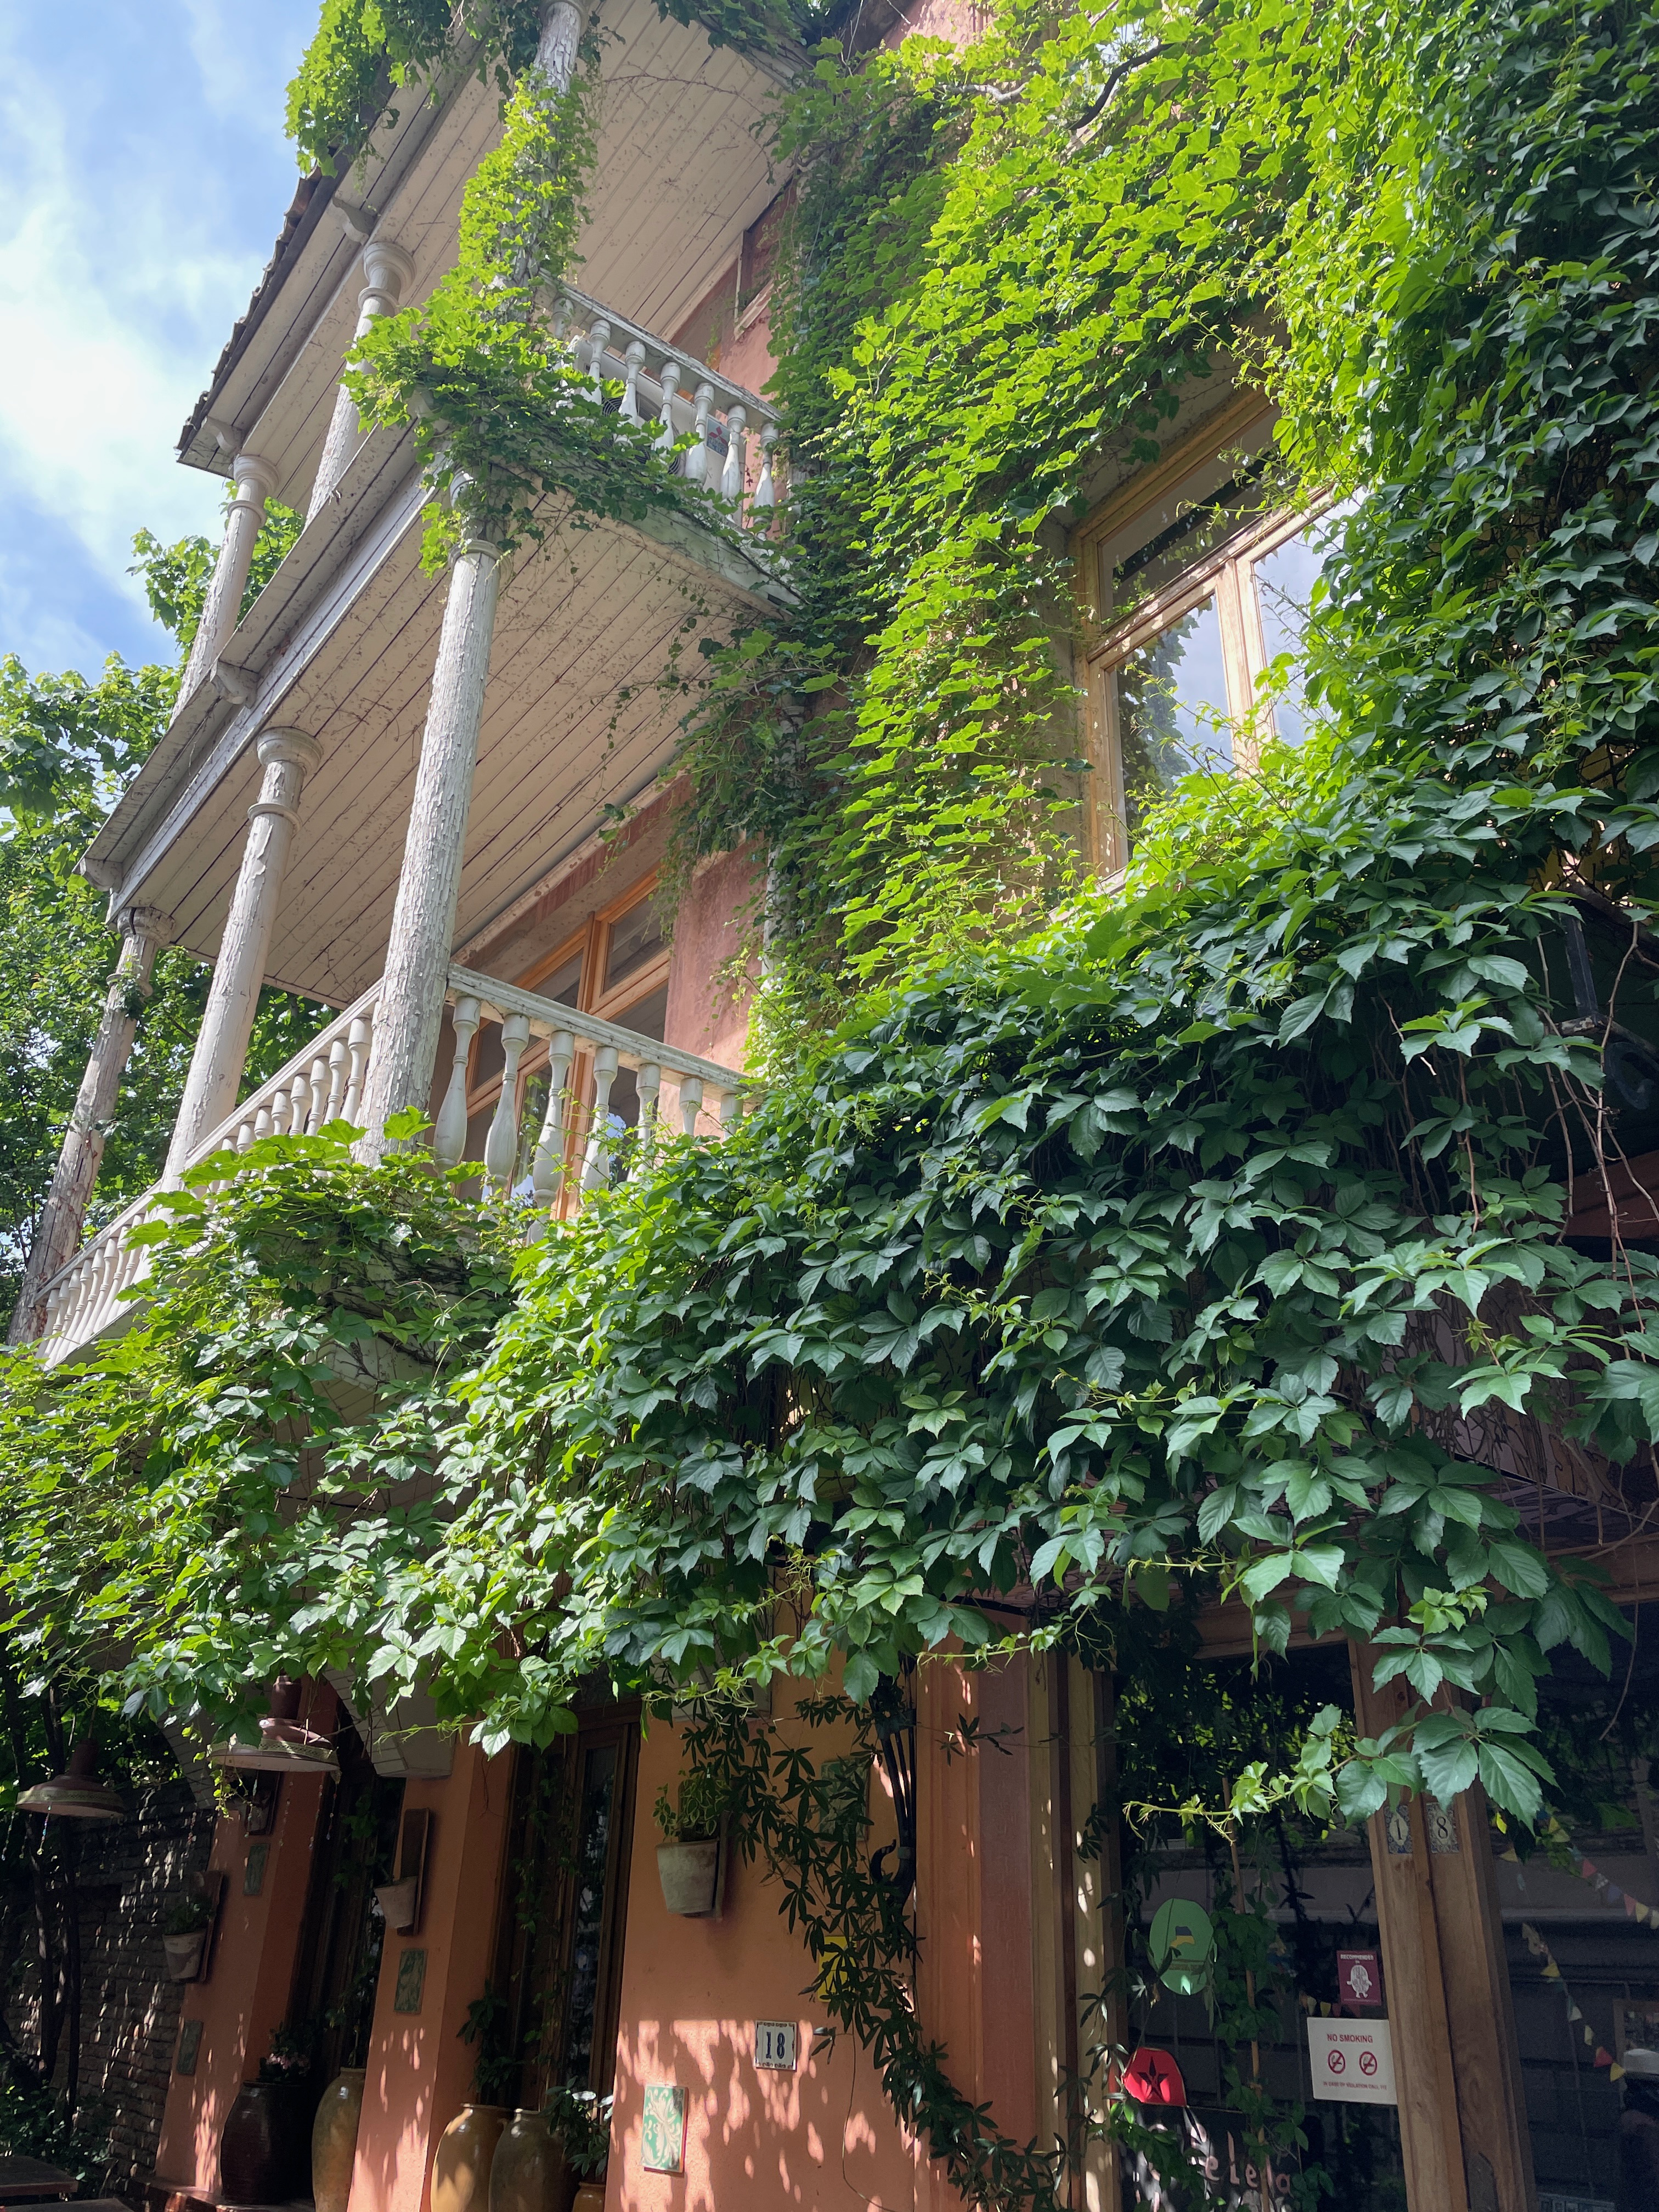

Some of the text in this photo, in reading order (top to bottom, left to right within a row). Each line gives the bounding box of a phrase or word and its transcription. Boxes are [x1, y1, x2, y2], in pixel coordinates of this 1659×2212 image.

[1394, 1816, 1448, 1841] 1 8
[766, 2032, 785, 2059] 18
[1340, 2034, 1373, 2043] SMOKING
